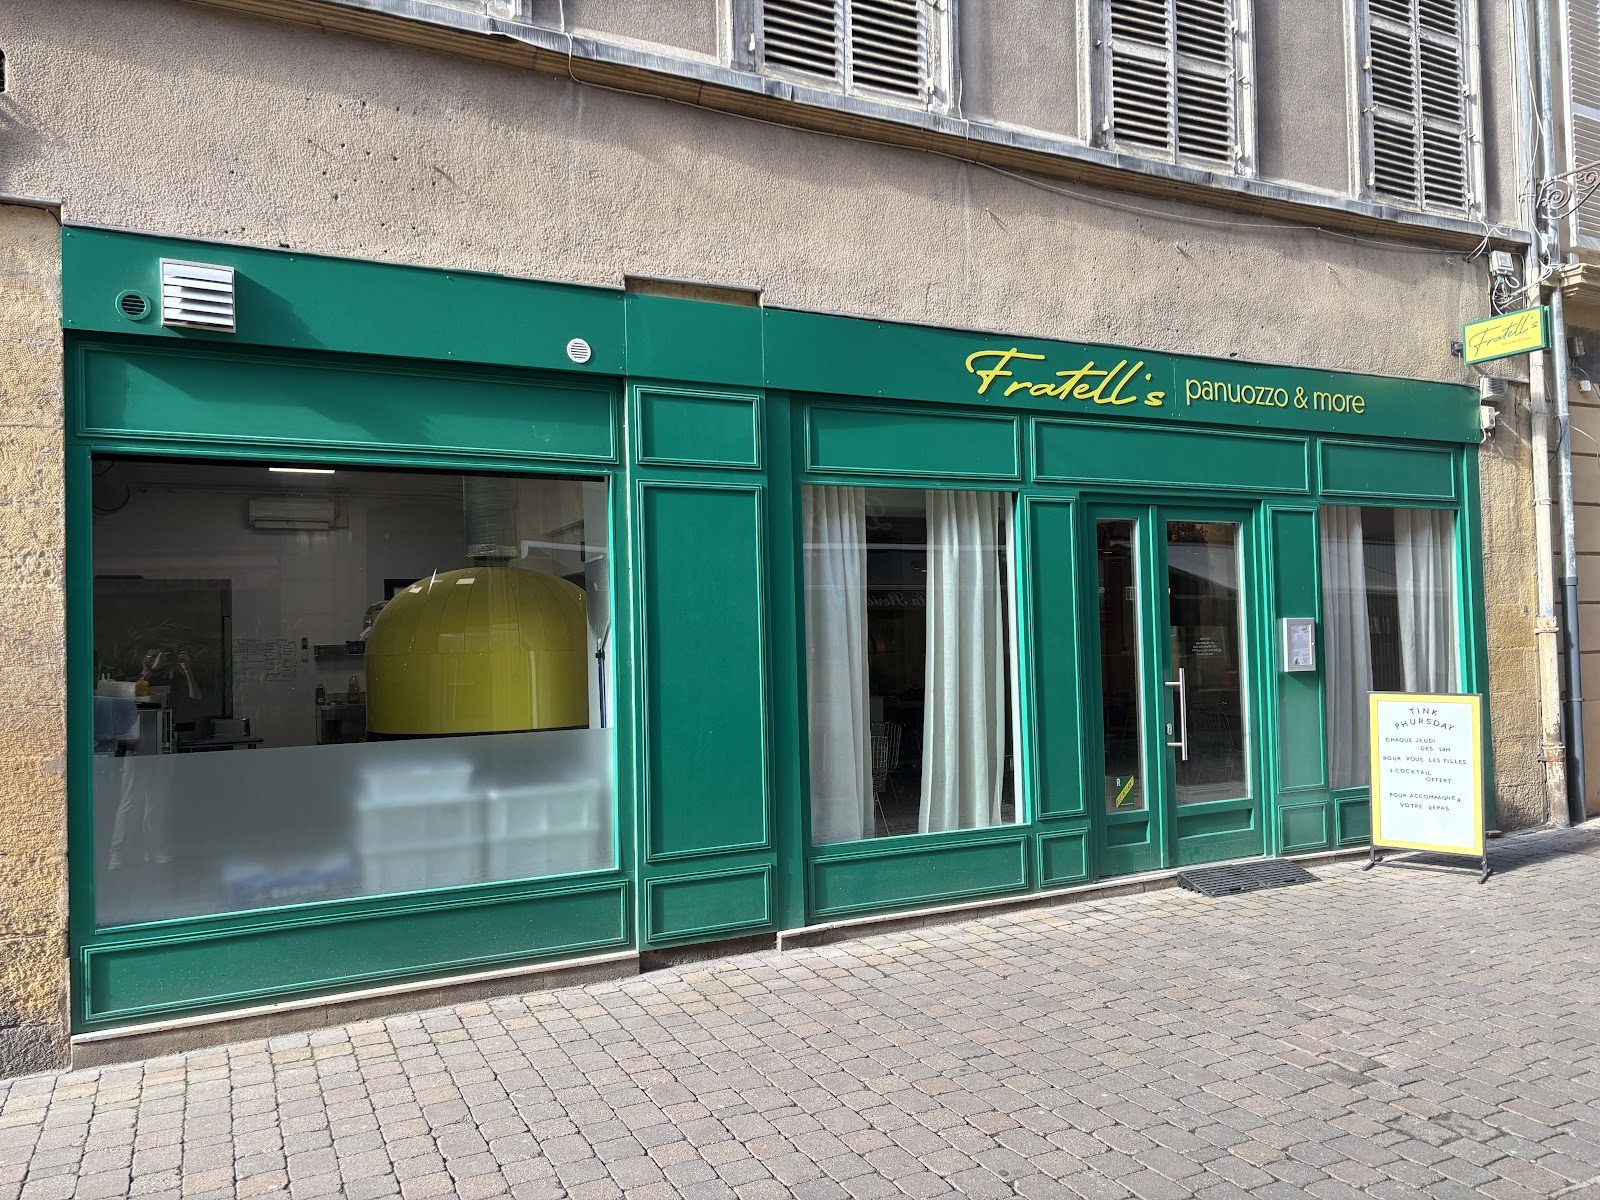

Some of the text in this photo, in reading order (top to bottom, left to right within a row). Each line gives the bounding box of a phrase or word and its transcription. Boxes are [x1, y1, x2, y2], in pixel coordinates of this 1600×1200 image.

[1469, 313, 1538, 357] Fratell's
[965, 347, 1366, 414] Fratell's panuozzo & more
[1408, 707, 1439, 717] TINK
[1394, 717, 1455, 731] PHURSDAY
[1394, 767, 1432, 776] COCKTAIL
[1425, 776, 1452, 784] OFFERT
